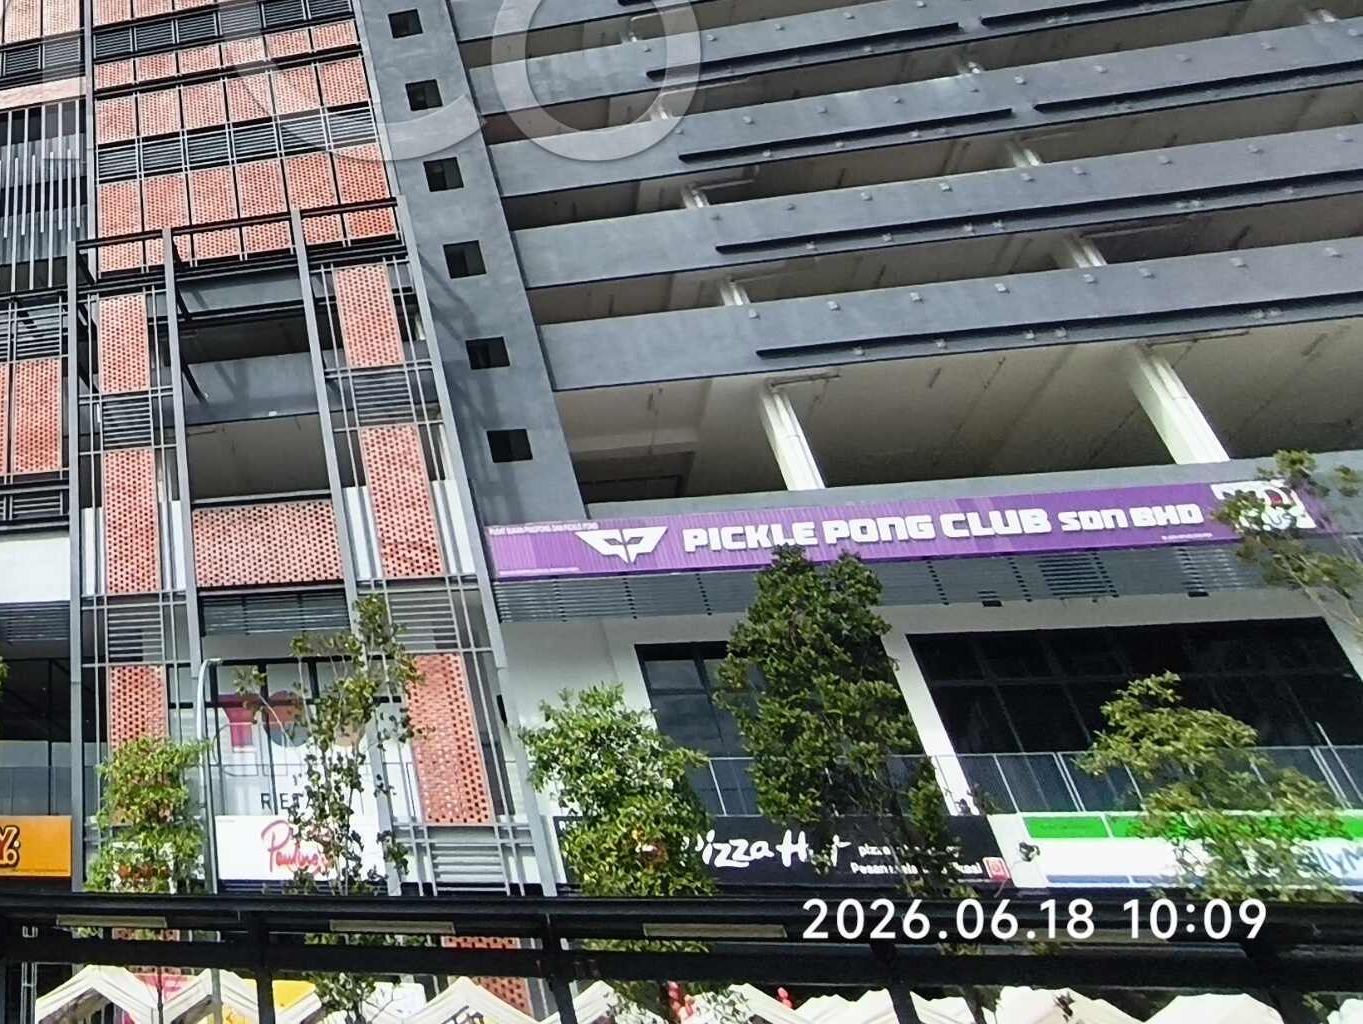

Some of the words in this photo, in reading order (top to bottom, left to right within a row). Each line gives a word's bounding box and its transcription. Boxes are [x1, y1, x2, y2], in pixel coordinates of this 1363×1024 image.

[682, 521, 818, 553] PICKLE
[822, 514, 936, 545] PONG
[939, 508, 1052, 538] CLUB
[1130, 503, 1204, 527] BHD
[776, 829, 851, 868] Ht
